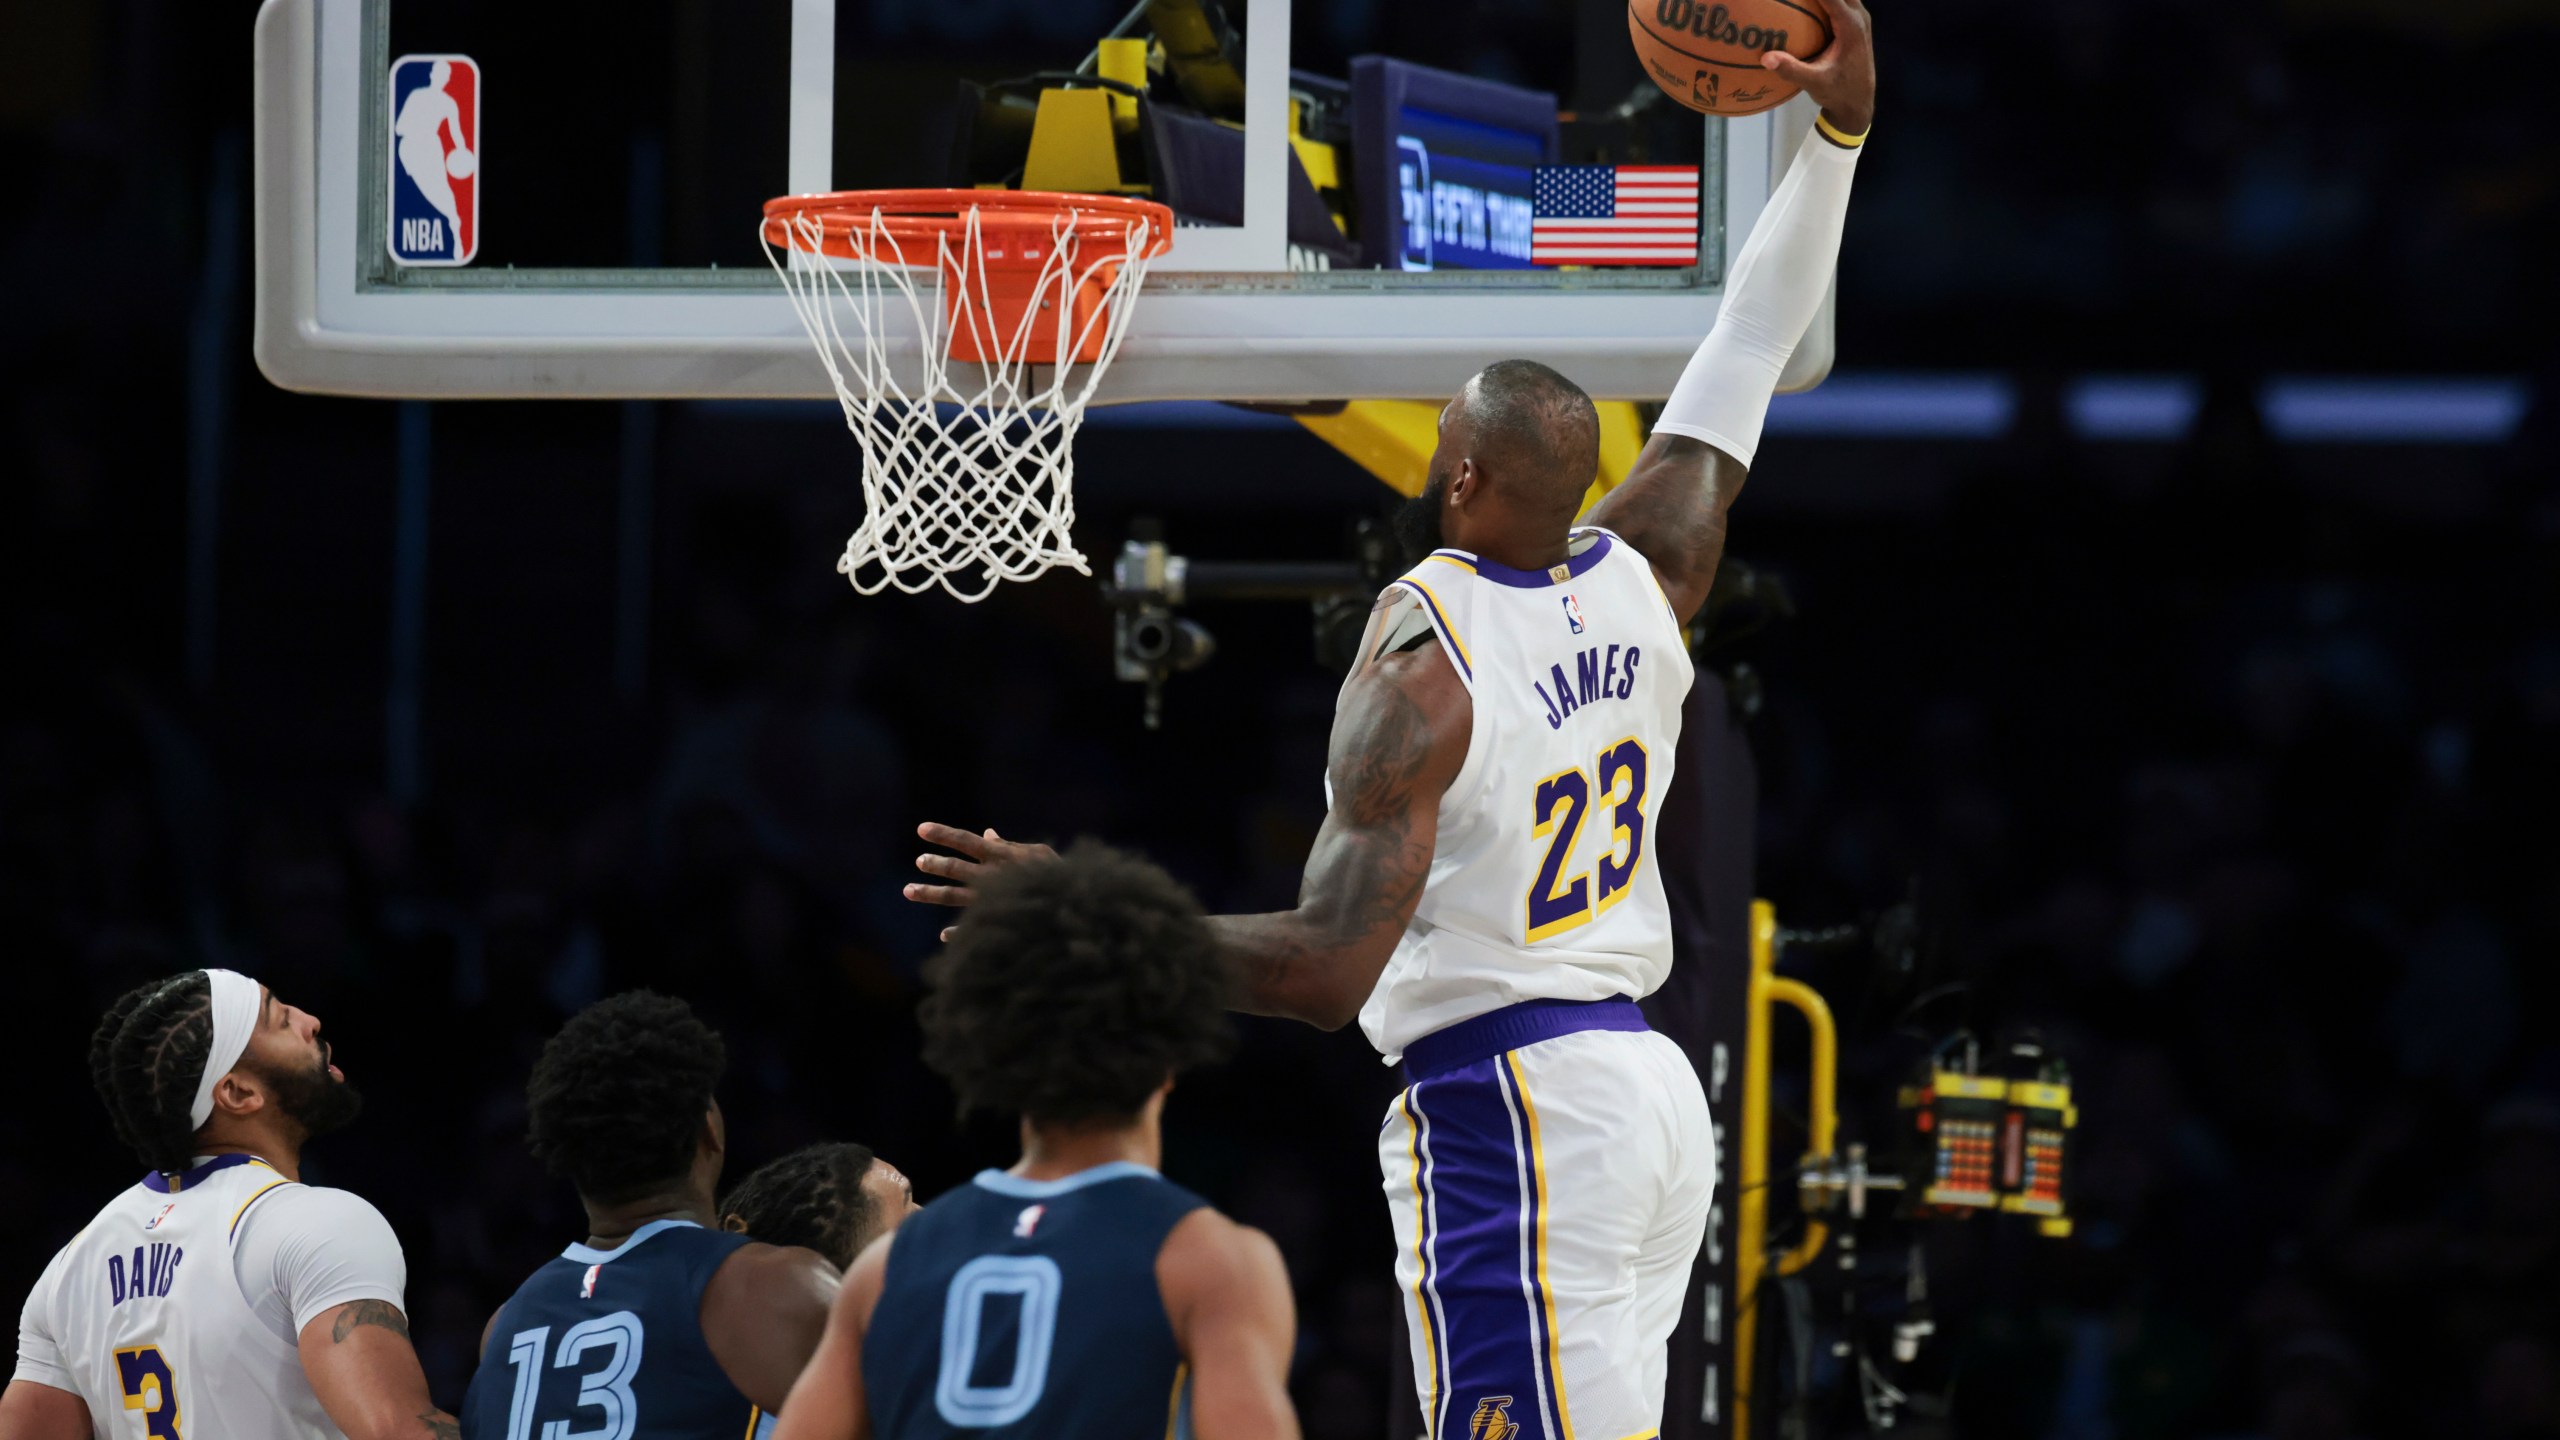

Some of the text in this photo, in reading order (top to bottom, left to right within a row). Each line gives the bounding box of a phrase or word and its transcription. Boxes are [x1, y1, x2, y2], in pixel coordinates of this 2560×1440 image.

[1656, 0, 1788, 51] Wilson
[402, 218, 445, 252] NBA
[1433, 180, 1486, 251] FIFTH
[1534, 644, 1640, 730] JAMES
[1525, 735, 1649, 945] 23
[108, 1243, 183, 1307] DAVIS
[506, 1310, 643, 1440] 13
[935, 1254, 1062, 1428] 0
[112, 1344, 184, 1440] 3
